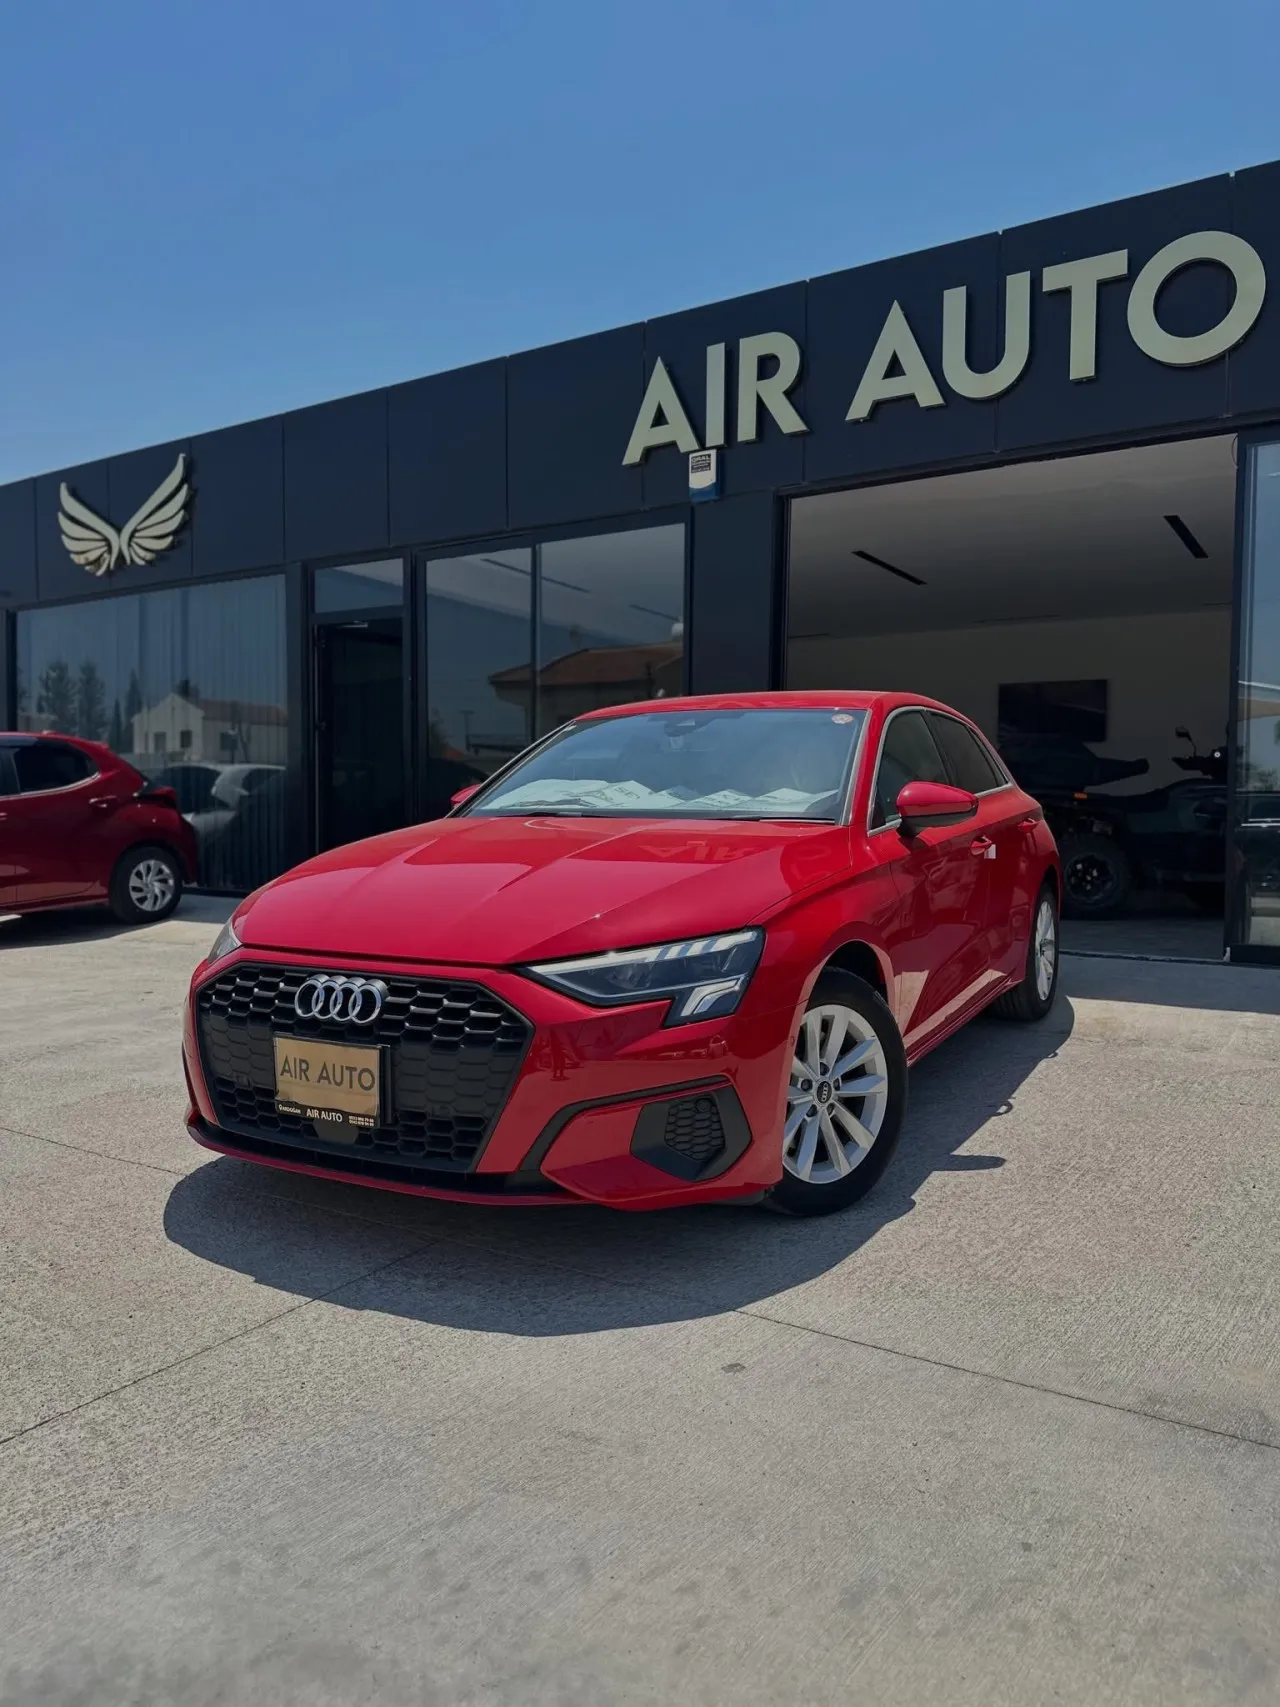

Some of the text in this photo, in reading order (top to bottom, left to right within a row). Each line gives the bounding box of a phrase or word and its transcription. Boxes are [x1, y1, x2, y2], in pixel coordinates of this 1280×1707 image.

[622, 230, 1267, 466] AIR AUTO
[280, 1055, 376, 1091] AIR AUTO
[306, 1108, 320, 1119] AIR
[321, 1111, 343, 1122] AUTO
